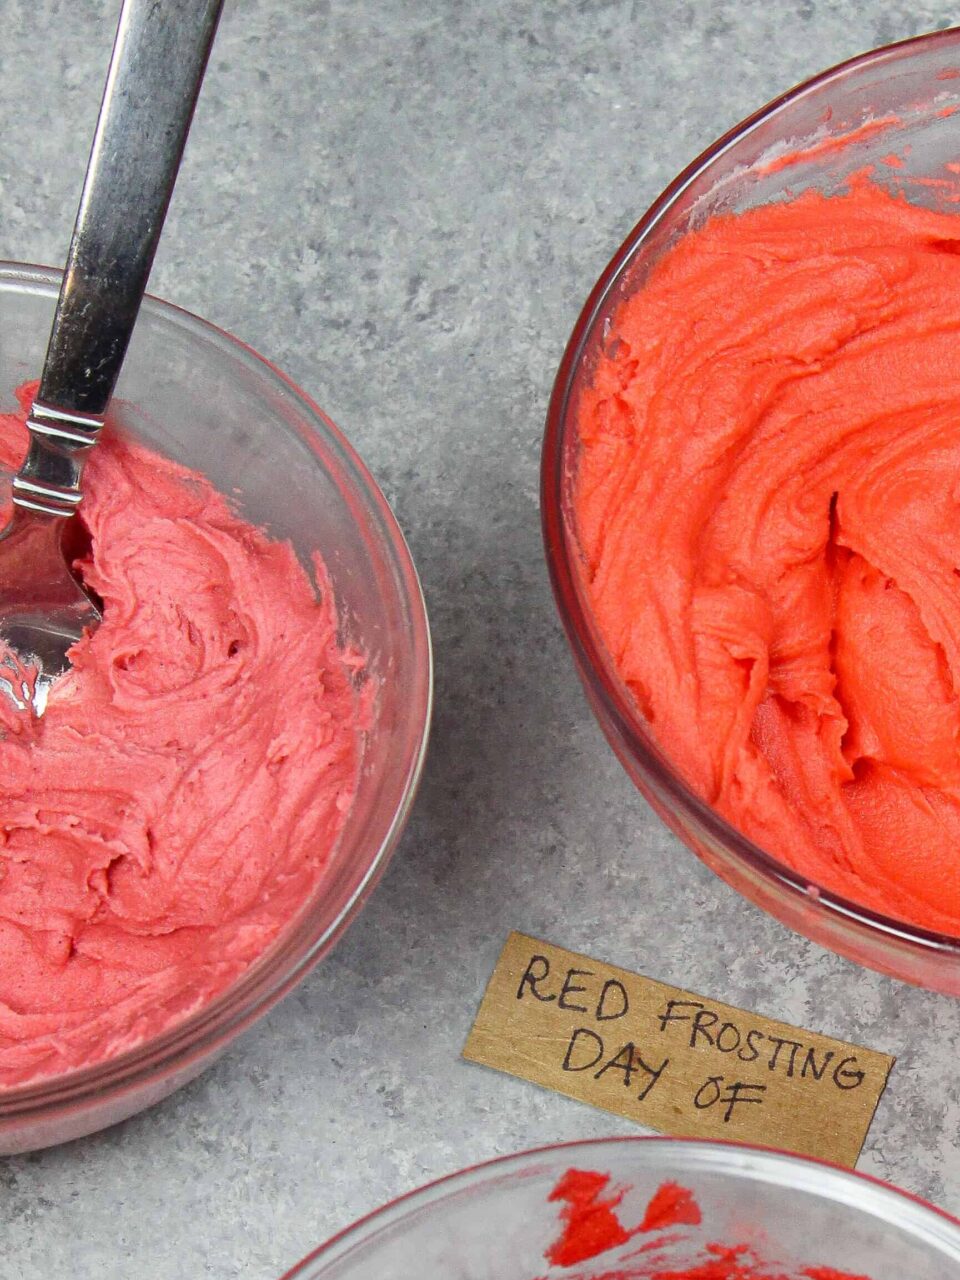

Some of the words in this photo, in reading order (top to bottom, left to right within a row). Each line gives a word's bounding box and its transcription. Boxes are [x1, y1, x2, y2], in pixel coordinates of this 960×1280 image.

[516, 954, 630, 1022] RED
[657, 1000, 866, 1091] FROSTING
[561, 1028, 670, 1101] DAY
[693, 1075, 768, 1123] OF
